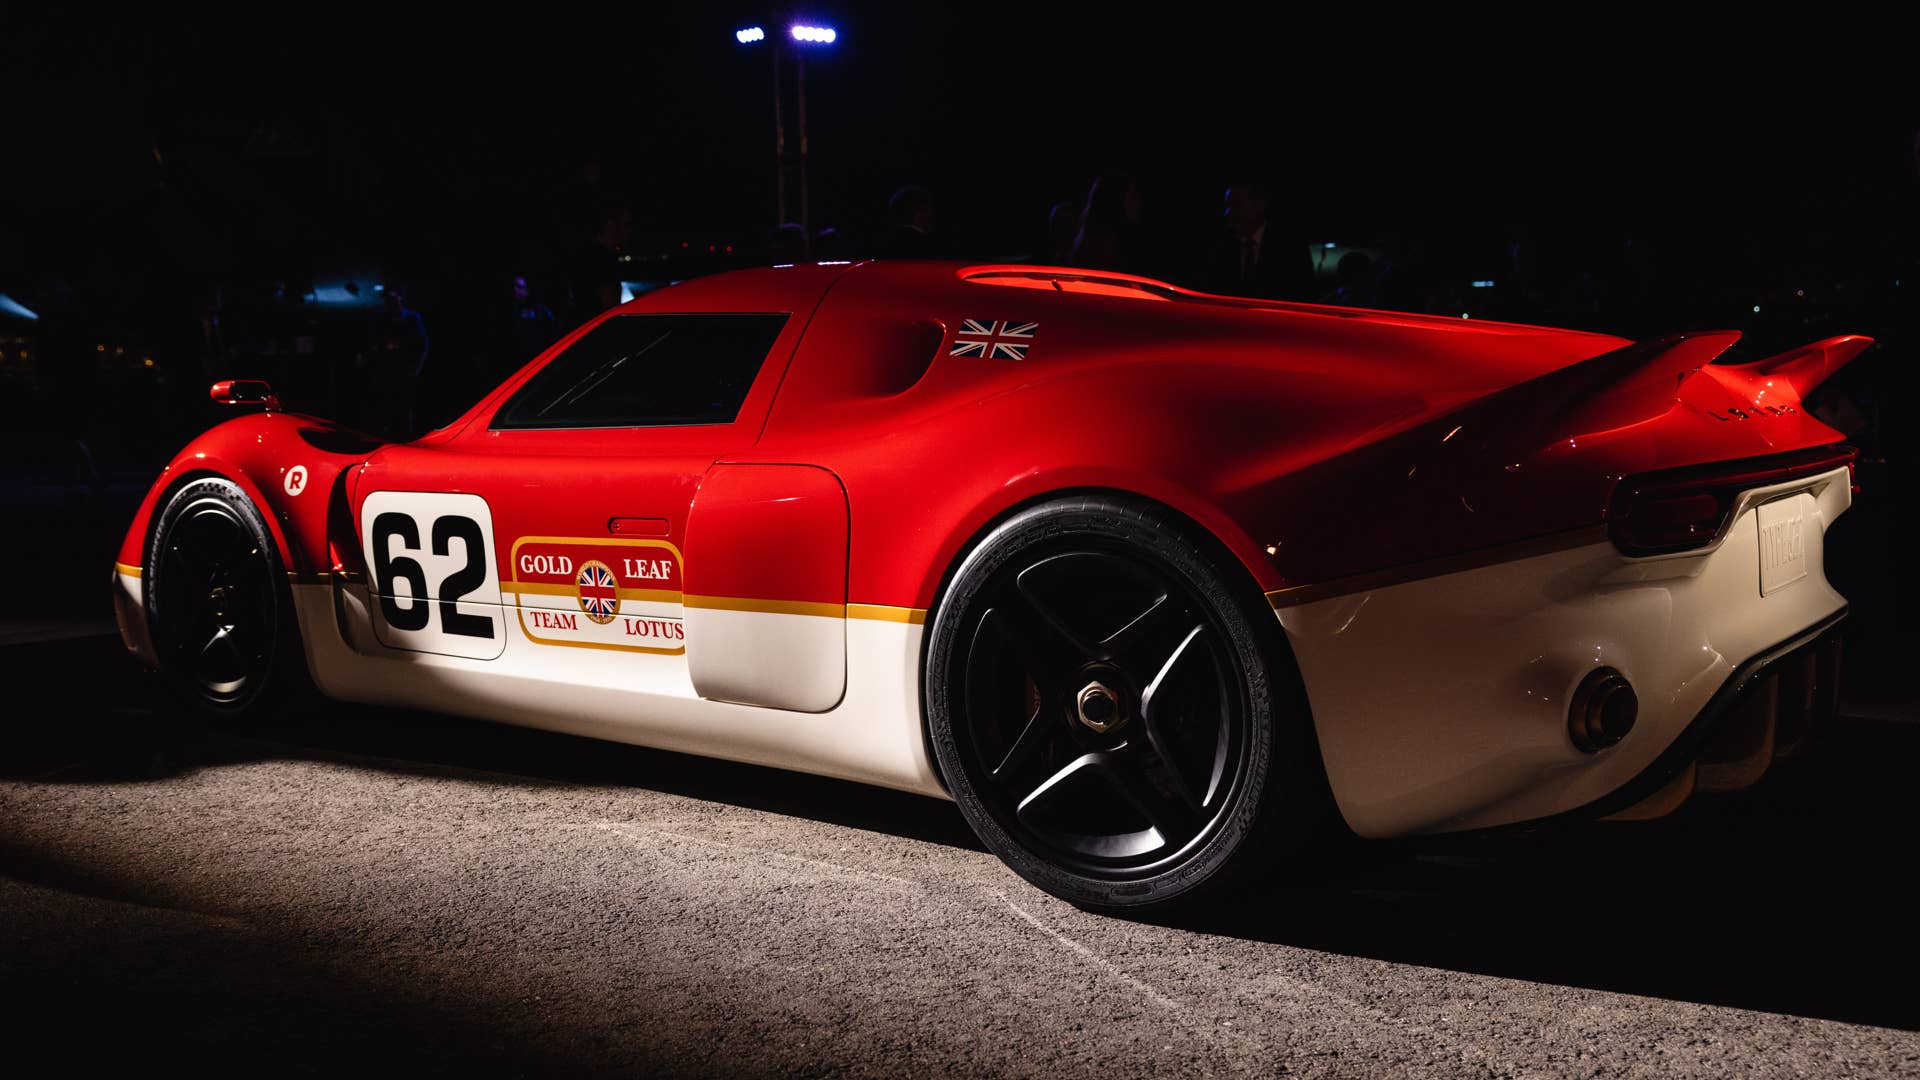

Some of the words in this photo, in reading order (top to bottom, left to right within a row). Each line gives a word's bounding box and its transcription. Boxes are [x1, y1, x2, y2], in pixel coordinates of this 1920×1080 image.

[289, 471, 303, 490] R
[372, 511, 495, 639] 62
[520, 554, 573, 575] GOLD
[623, 558, 672, 580] LEAF
[530, 611, 578, 631] TEAM
[624, 618, 685, 640] LOTUS
